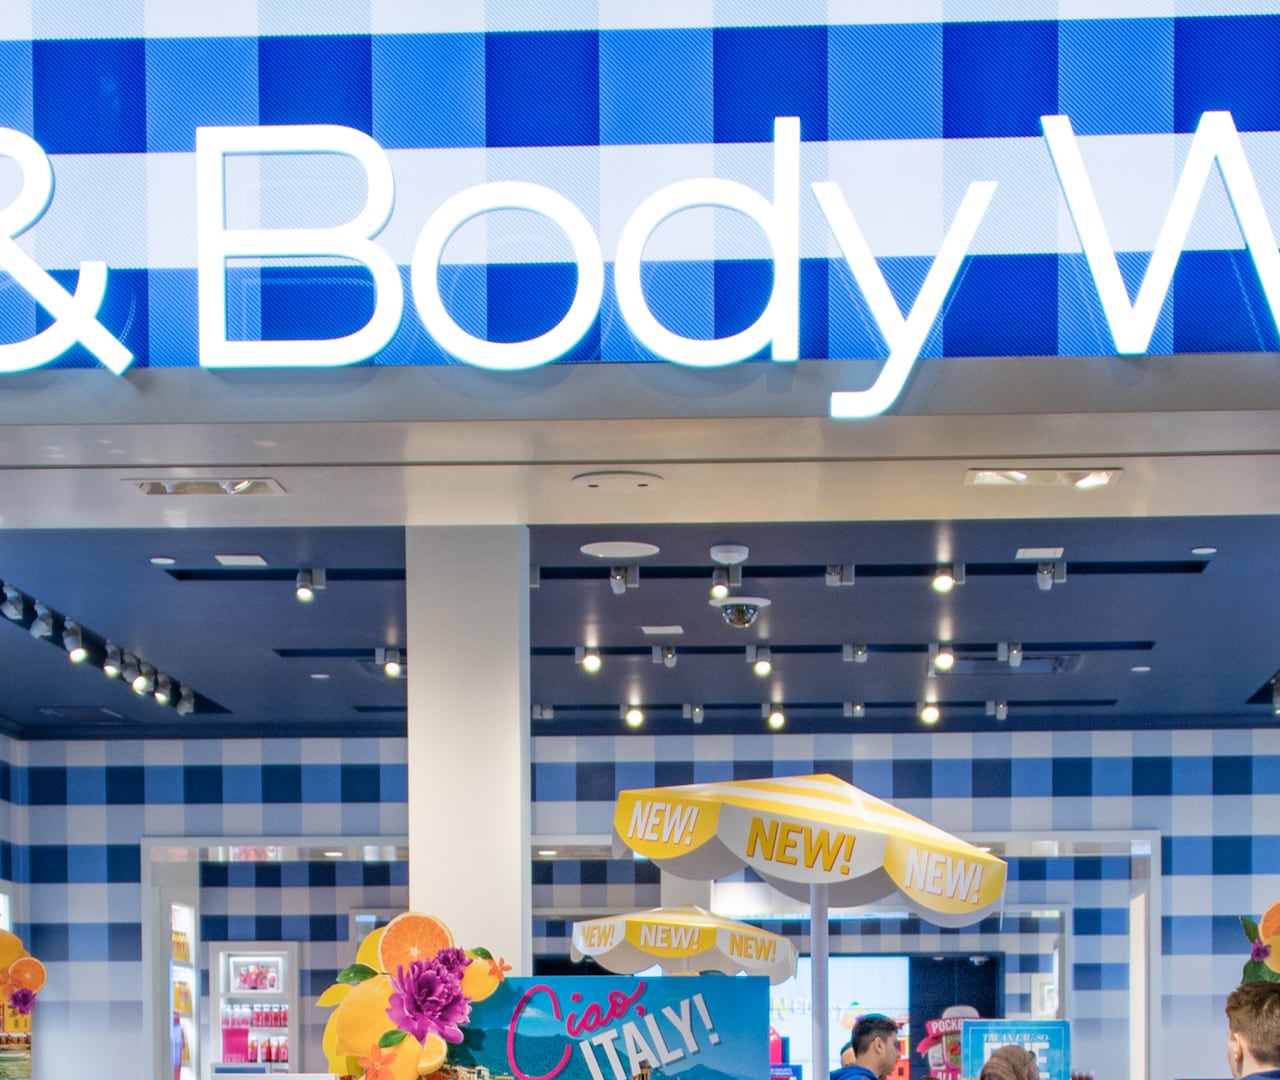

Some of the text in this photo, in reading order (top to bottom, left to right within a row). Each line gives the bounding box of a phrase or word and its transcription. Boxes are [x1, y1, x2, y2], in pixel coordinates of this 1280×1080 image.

[195, 114, 999, 420] Body
[626, 799, 700, 846] NEW!
[746, 815, 857, 877] NEW!
[903, 846, 985, 905] NEW!
[639, 923, 701, 950] NEW!
[729, 932, 777, 963] NEW!
